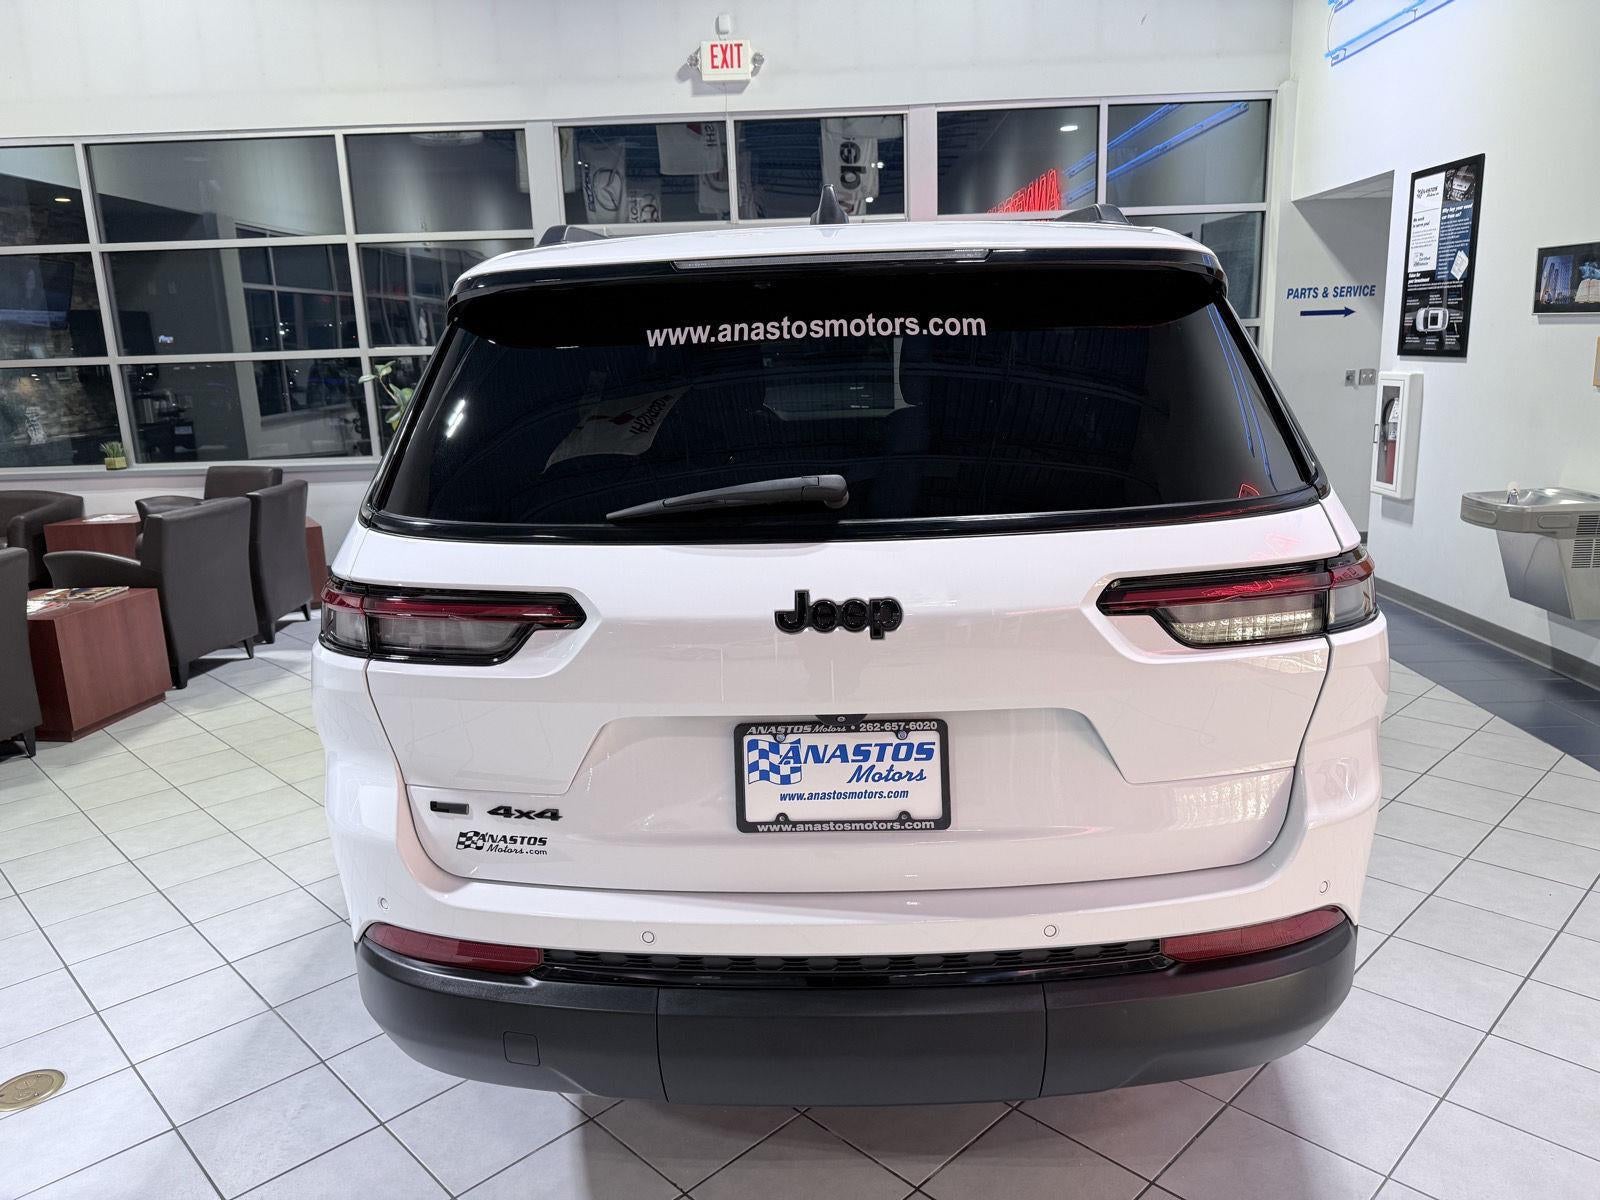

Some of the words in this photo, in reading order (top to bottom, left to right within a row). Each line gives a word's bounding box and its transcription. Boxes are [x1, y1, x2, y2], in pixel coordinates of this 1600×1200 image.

[710, 43, 743, 69] EXIT
[1286, 287, 1319, 299] PARTS
[1321, 286, 1329, 298] &
[1332, 285, 1376, 298] SERVICE
[646, 313, 987, 347] www.anastosmotors.com
[774, 589, 904, 639] Jeep
[746, 724, 812, 735] ANASTOS
[812, 724, 847, 733] Motors
[859, 721, 938, 732] 262-657-6020
[778, 741, 936, 765] ANASTOS
[846, 764, 927, 784] Motors
[779, 789, 909, 801] www.anastosmotors.com
[486, 805, 563, 821] 4x4
[757, 820, 935, 832] www.anastosmotors.com
[477, 832, 548, 846] ANASTOS
